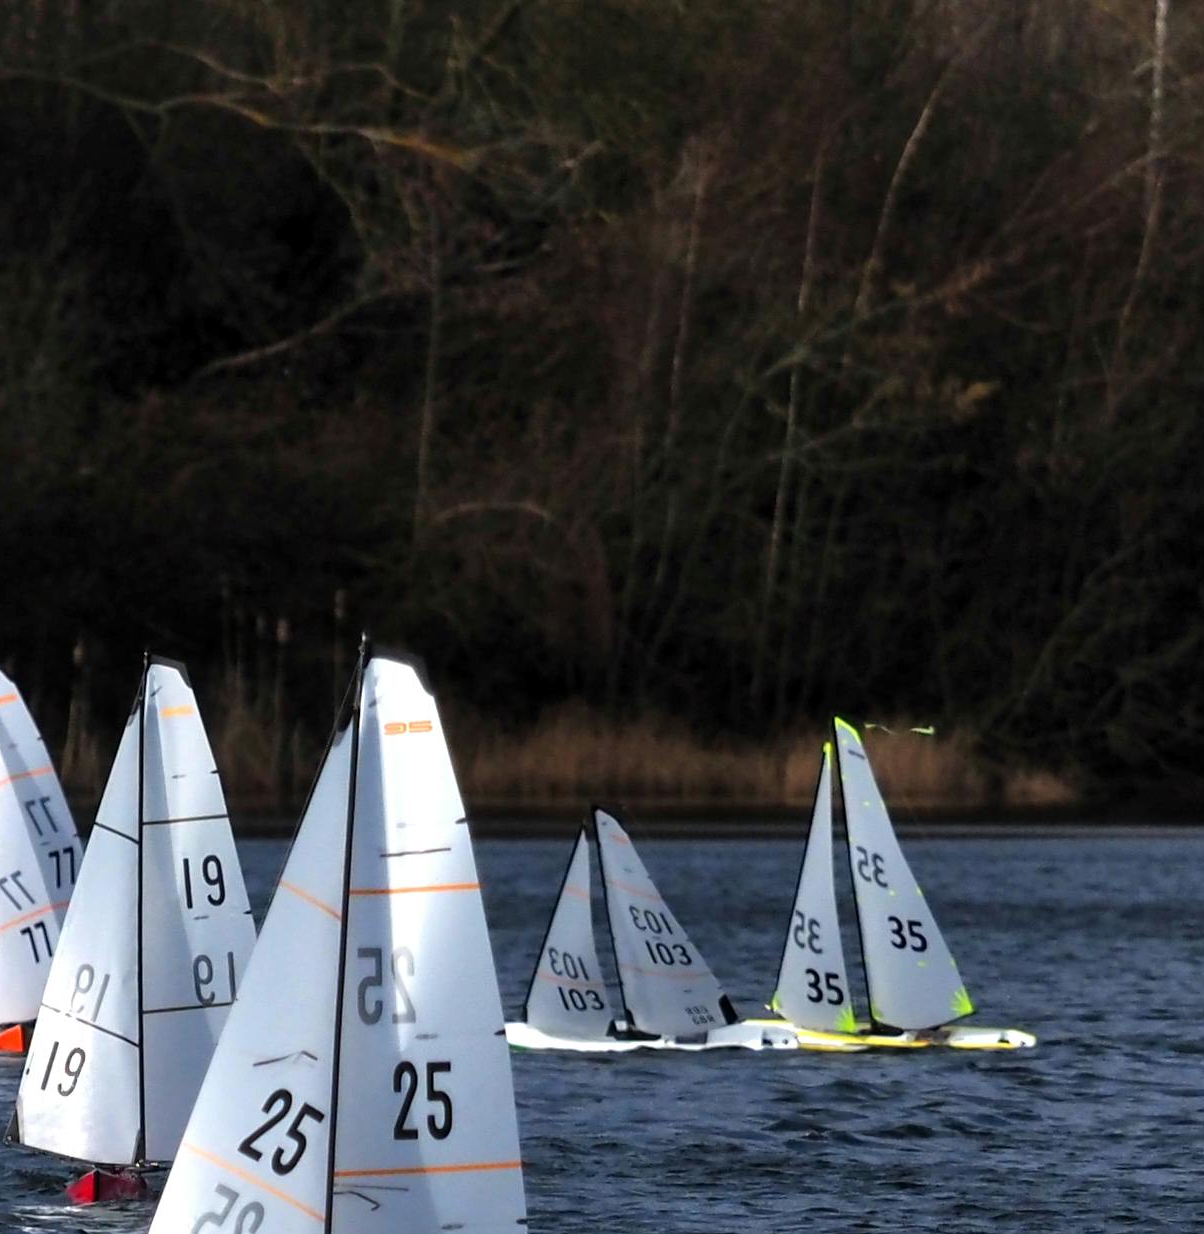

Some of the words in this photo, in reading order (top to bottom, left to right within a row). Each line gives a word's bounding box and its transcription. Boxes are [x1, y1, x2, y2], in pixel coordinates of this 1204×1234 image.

[48, 846, 76, 889] 77
[182, 855, 226, 910] 19
[20, 920, 53, 963] 77
[645, 940, 693, 966] 103
[887, 915, 928, 952] 35
[558, 986, 605, 1012] 103
[804, 967, 845, 1006] 35
[40, 1041, 87, 1097] 19
[393, 1061, 453, 1141] 25
[237, 1088, 325, 1177] 25
